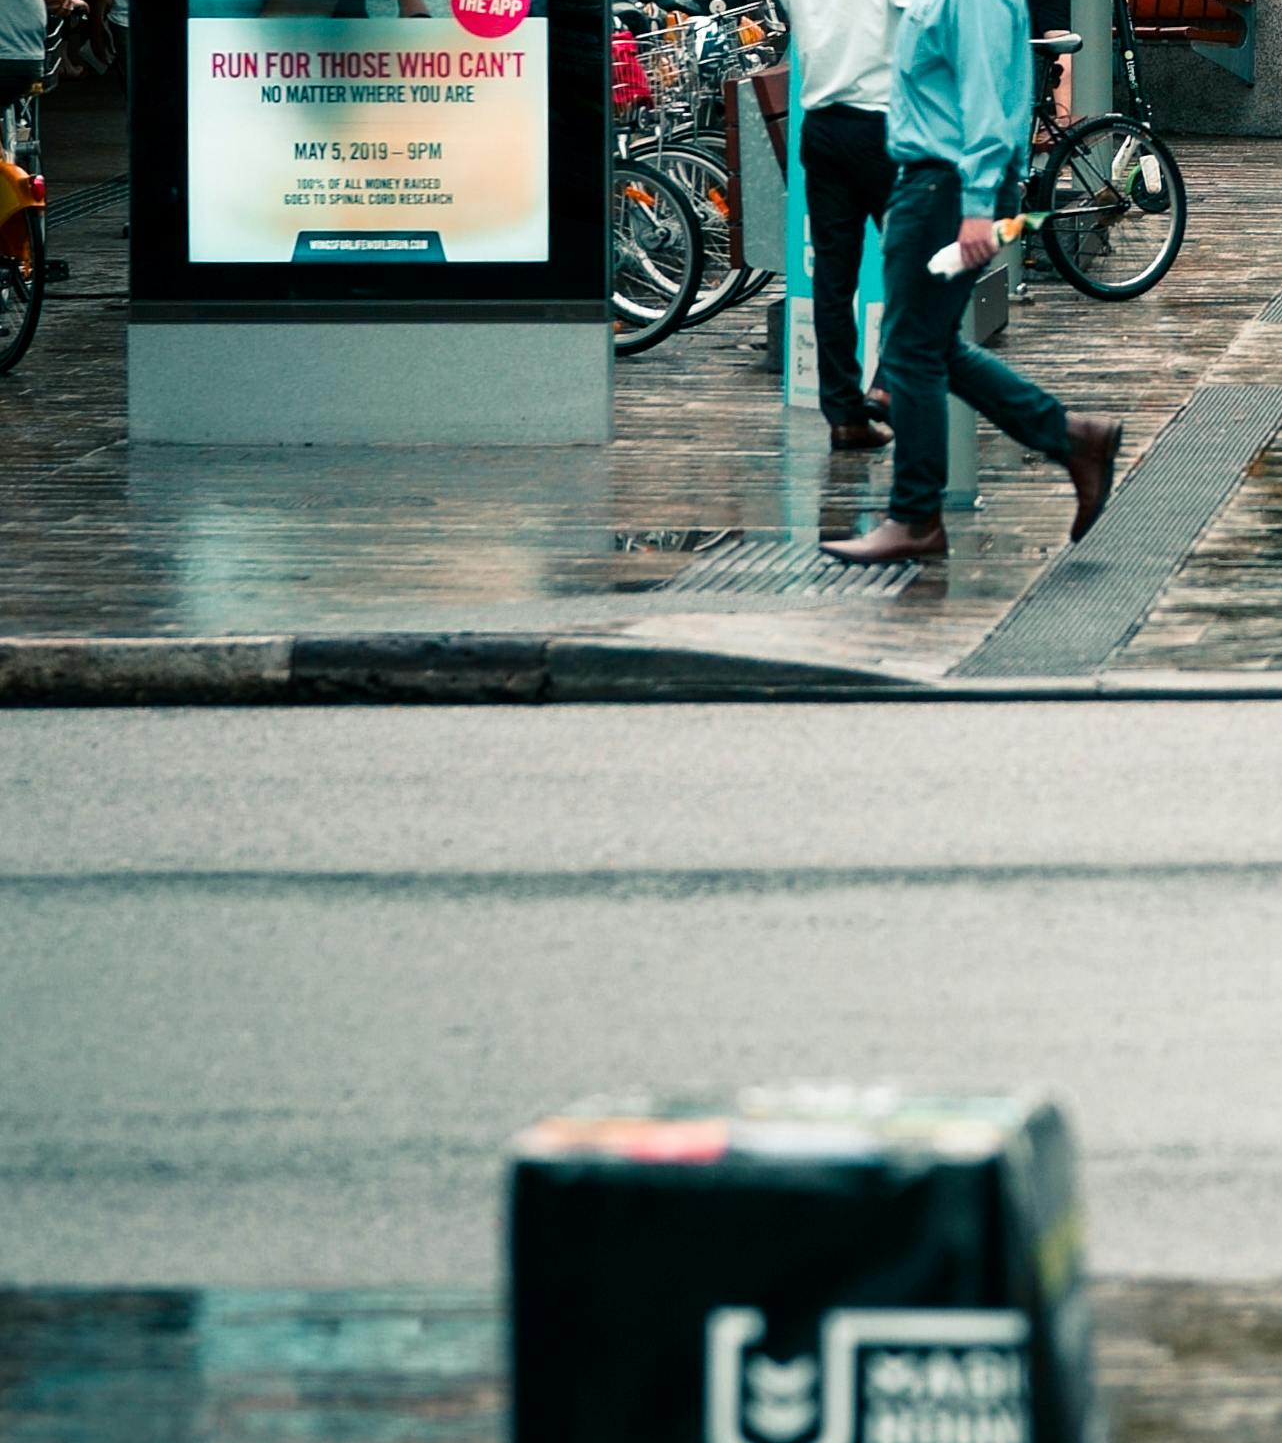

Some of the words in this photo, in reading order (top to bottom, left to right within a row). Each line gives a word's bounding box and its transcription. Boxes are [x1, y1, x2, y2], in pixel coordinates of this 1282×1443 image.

[211, 52, 258, 78] RUN
[265, 52, 311, 78] FOR
[317, 52, 391, 78] THOSE
[396, 52, 450, 78] WHO
[458, 52, 526, 78] CAN'T
[261, 85, 282, 103] NO
[286, 85, 346, 103] MATTER
[350, 85, 406, 103] WHERE
[410, 85, 440, 103] YOU
[444, 85, 475, 103] ARE
[294, 142, 327, 160] MAY
[331, 142, 346, 163] 5,
[350, 142, 388, 160] 2019
[407, 142, 442, 160] 9PM
[297, 179, 325, 190] 100%
[329, 179, 340, 190] OF
[345, 179, 362, 190] ALL
[365, 179, 400, 190] MONEY
[403, 179, 441, 190] RAISED
[284, 194, 310, 205] GOES
[313, 194, 326, 205] TO
[329, 194, 366, 205] SPINAL
[368, 194, 396, 205] CORD
[400, 194, 453, 205] RESEARCH
